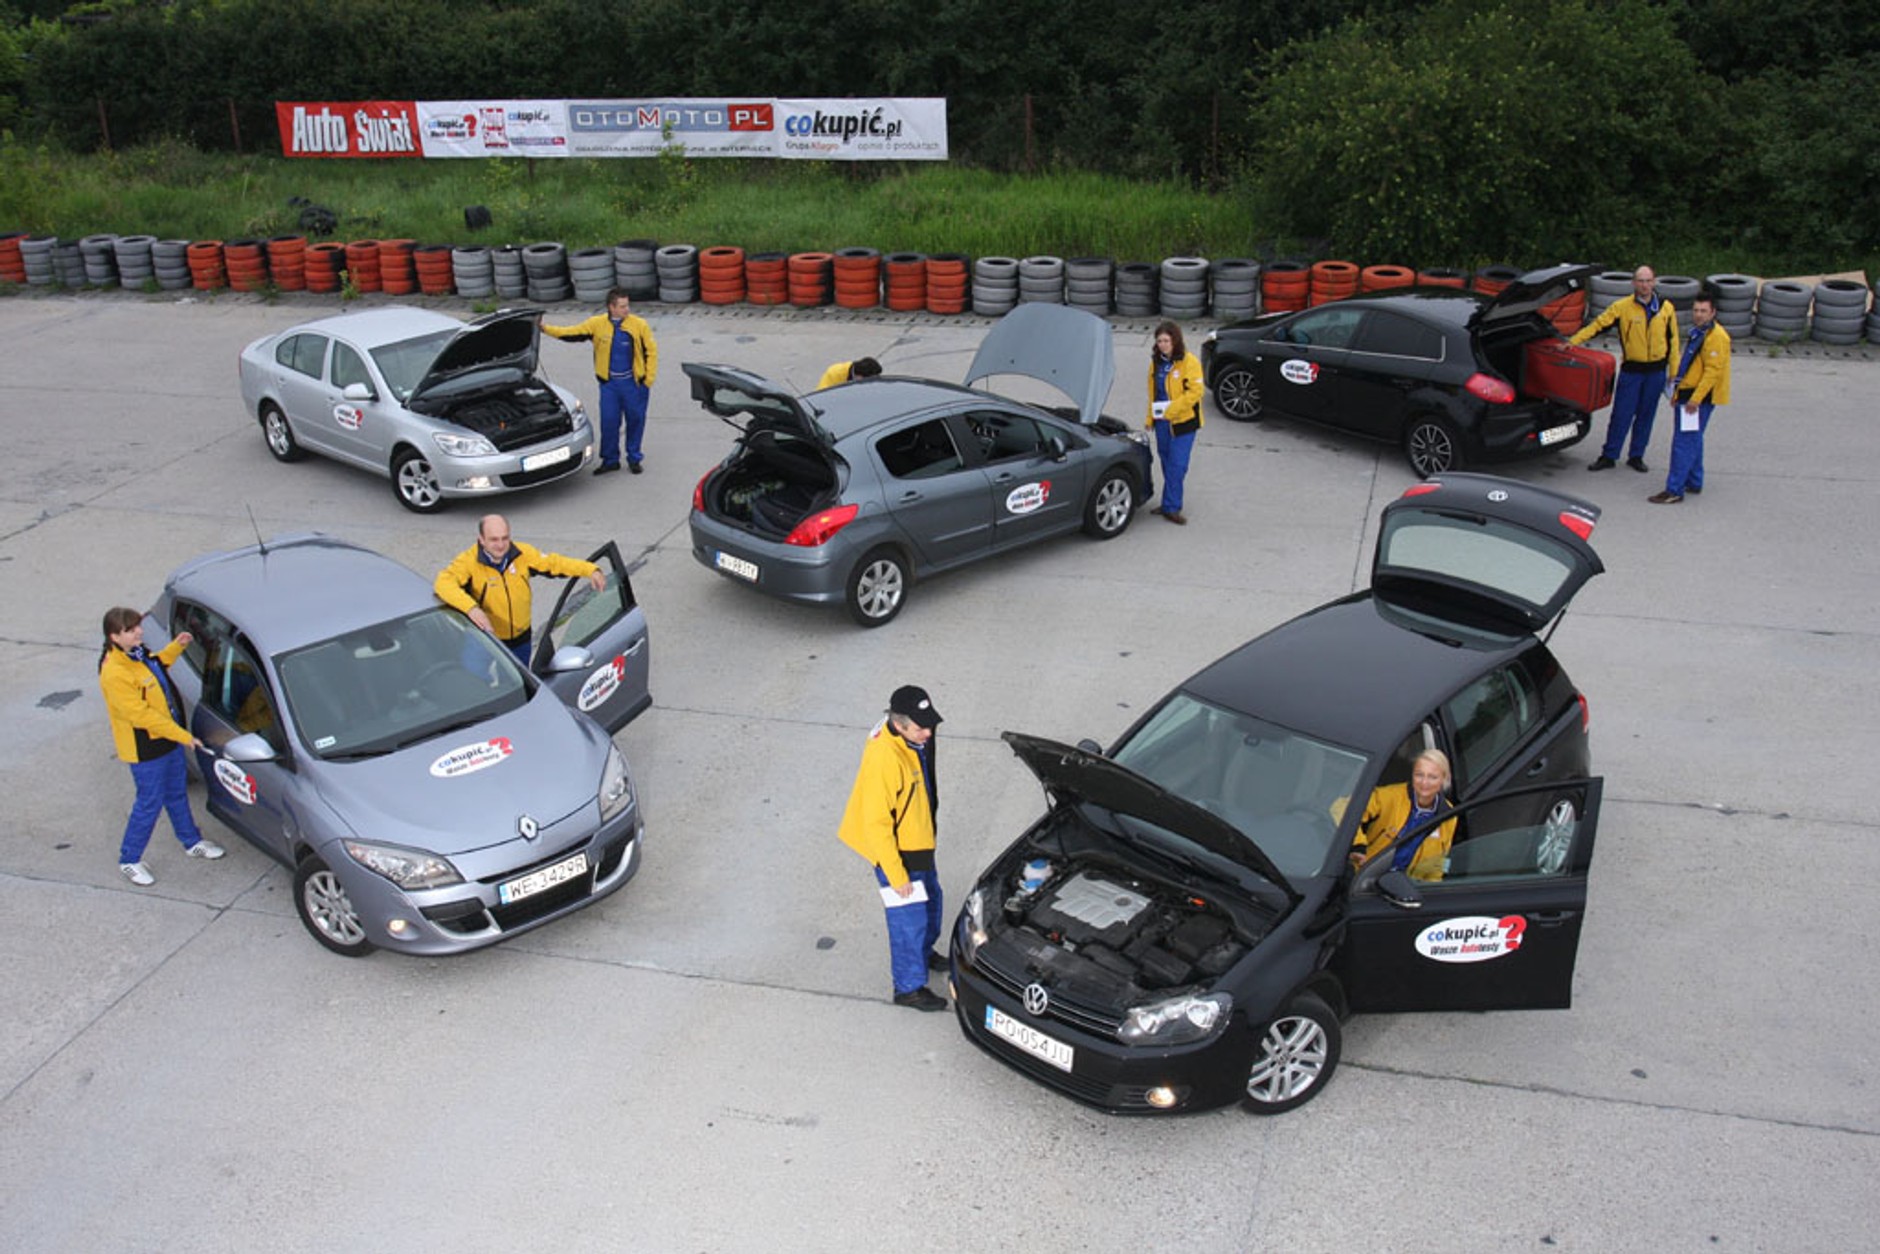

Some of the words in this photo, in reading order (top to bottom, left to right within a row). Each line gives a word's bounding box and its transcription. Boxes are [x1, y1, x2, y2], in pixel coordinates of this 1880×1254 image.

[292, 106, 348, 152] Auto
[785, 107, 902, 144] cokupić.pl
[1427, 924, 1499, 943] cokupić.pl
